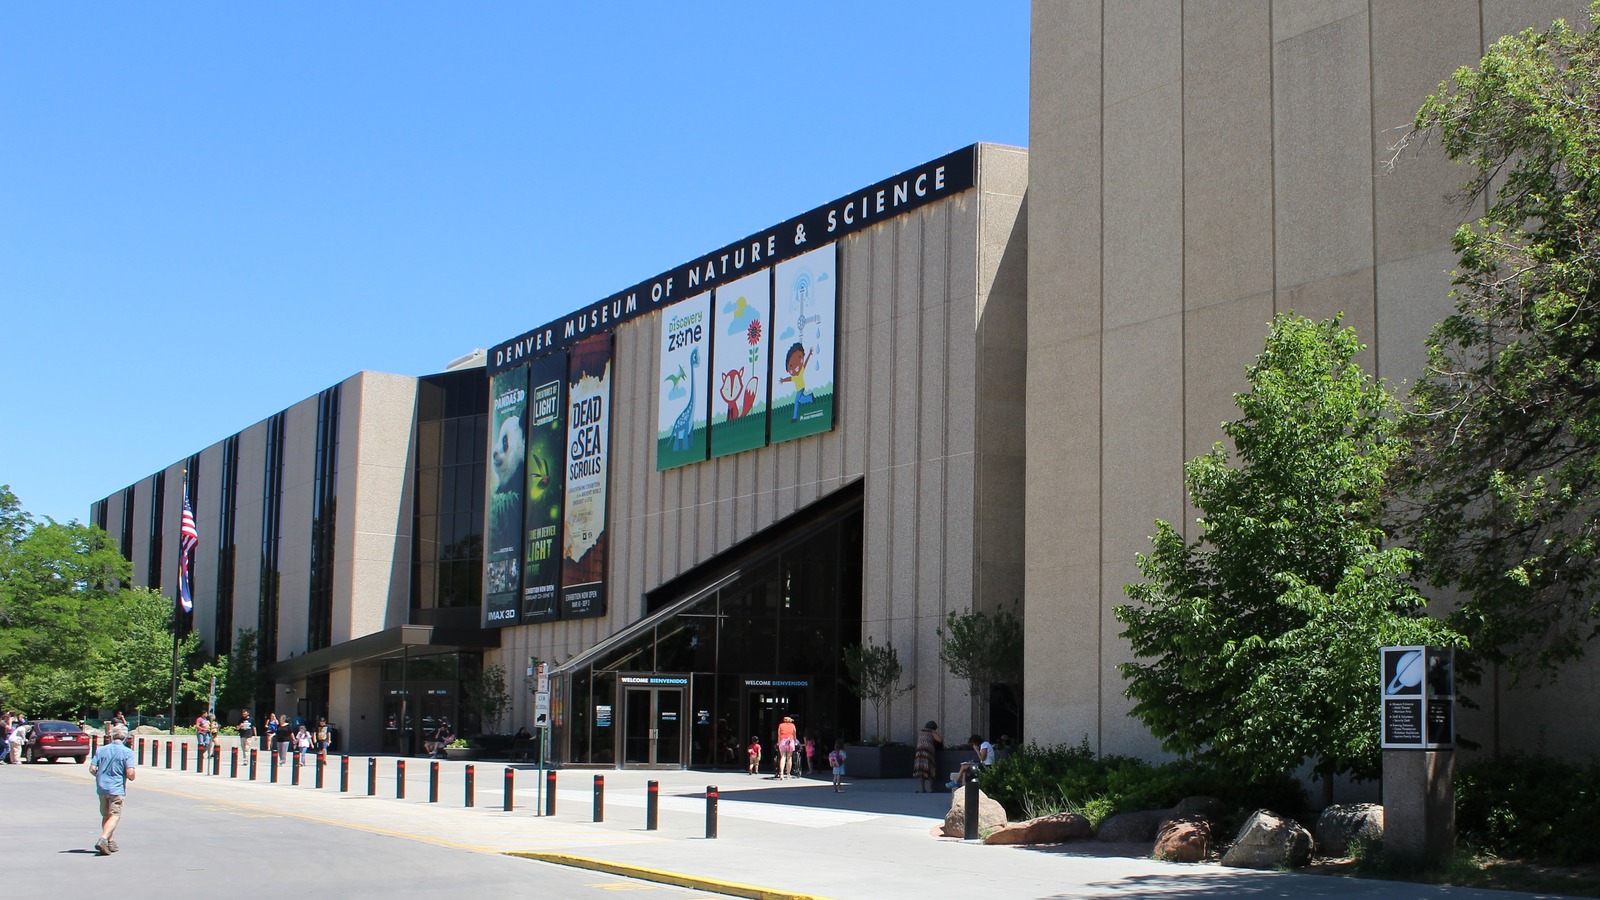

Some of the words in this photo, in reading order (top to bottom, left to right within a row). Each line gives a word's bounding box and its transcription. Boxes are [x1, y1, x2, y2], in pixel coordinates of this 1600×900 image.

[496, 330, 552, 366] DENVER
[564, 293, 638, 338] MUSEUM
[651, 277, 673, 302] OF
[689, 235, 775, 288] NATURE
[794, 223, 807, 246] &
[827, 165, 946, 233] SCIENCE
[494, 392, 517, 410] PANDAS
[517, 390, 525, 402] 3D
[535, 396, 557, 418] LIGHT
[573, 395, 602, 429] DEAD
[571, 424, 601, 461] SEA
[569, 456, 601, 480] SCROLLS
[527, 538, 553, 562] LIGHT
[488, 611, 504, 620] IMAX
[505, 609, 515, 619] 3D
